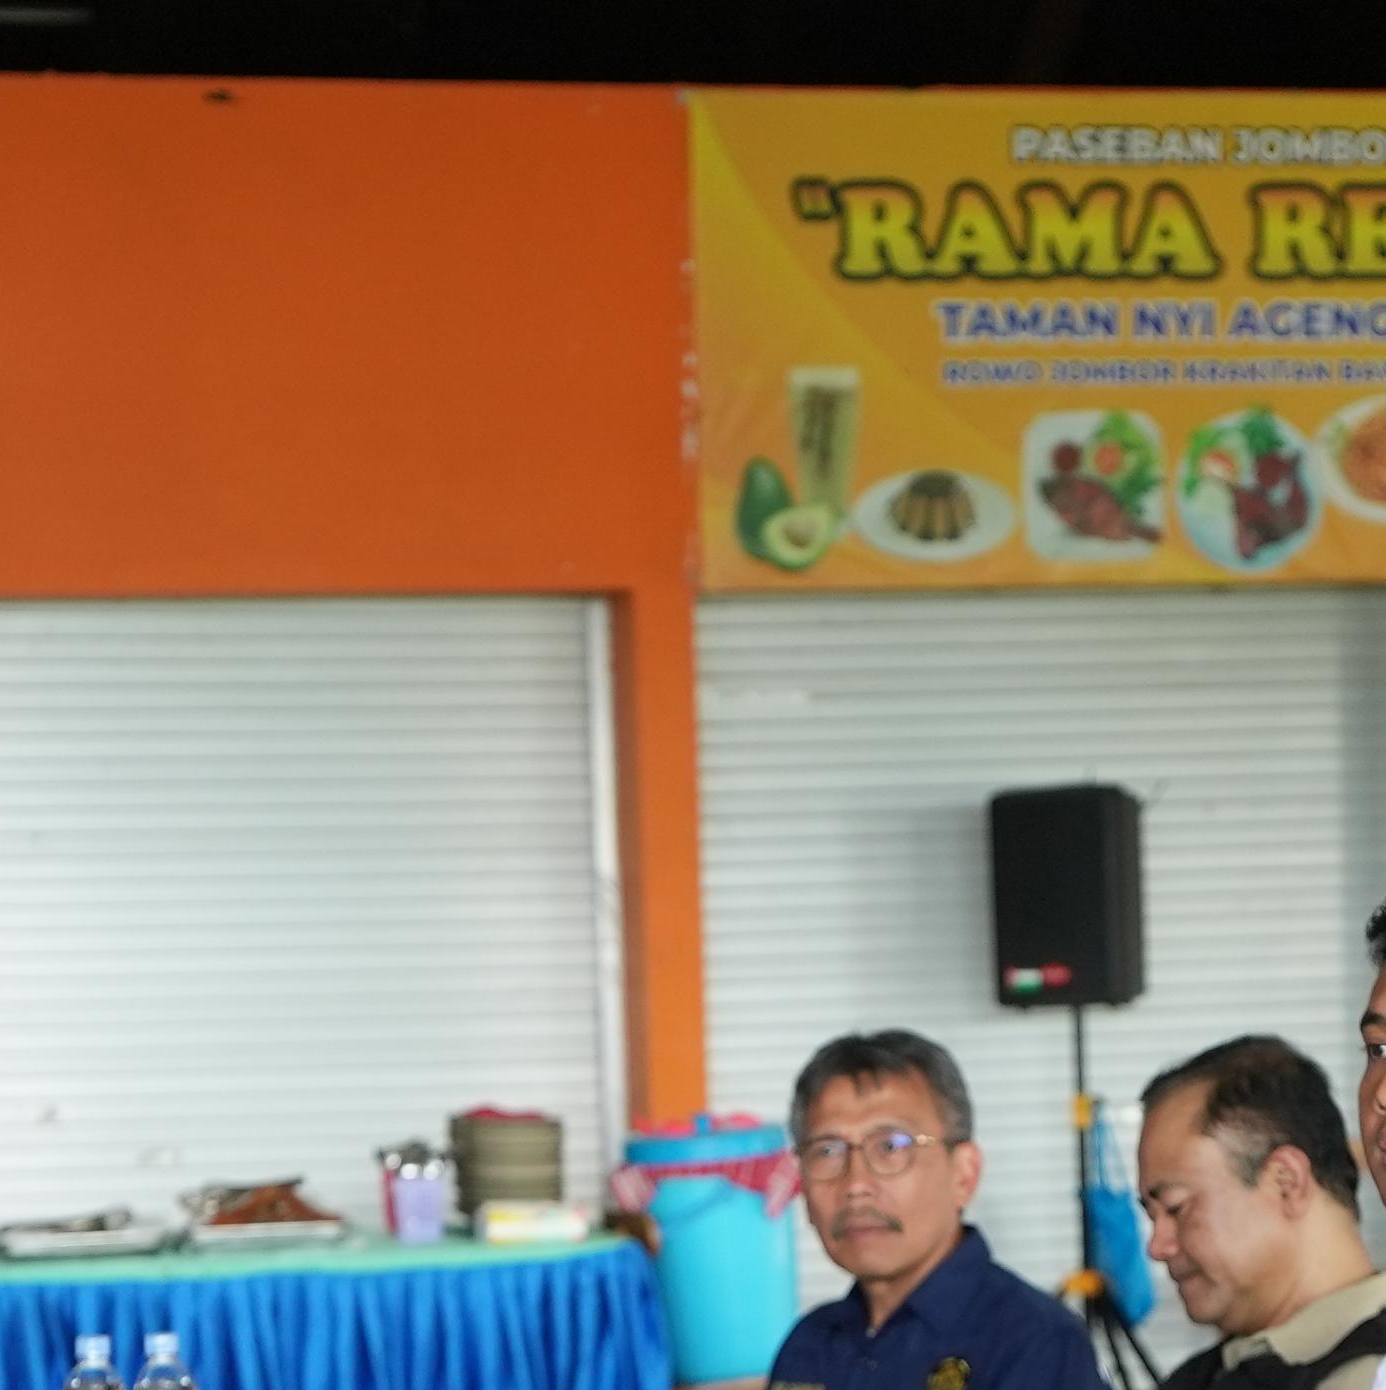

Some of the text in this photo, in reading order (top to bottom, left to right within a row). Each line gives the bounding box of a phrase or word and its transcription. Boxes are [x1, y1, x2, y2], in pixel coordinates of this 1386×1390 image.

[1014, 126, 1223, 164] PASEBAN
[792, 176, 1223, 281] "RAMA
[939, 302, 1116, 340] TAMAN
[1131, 302, 1213, 340] NYI
